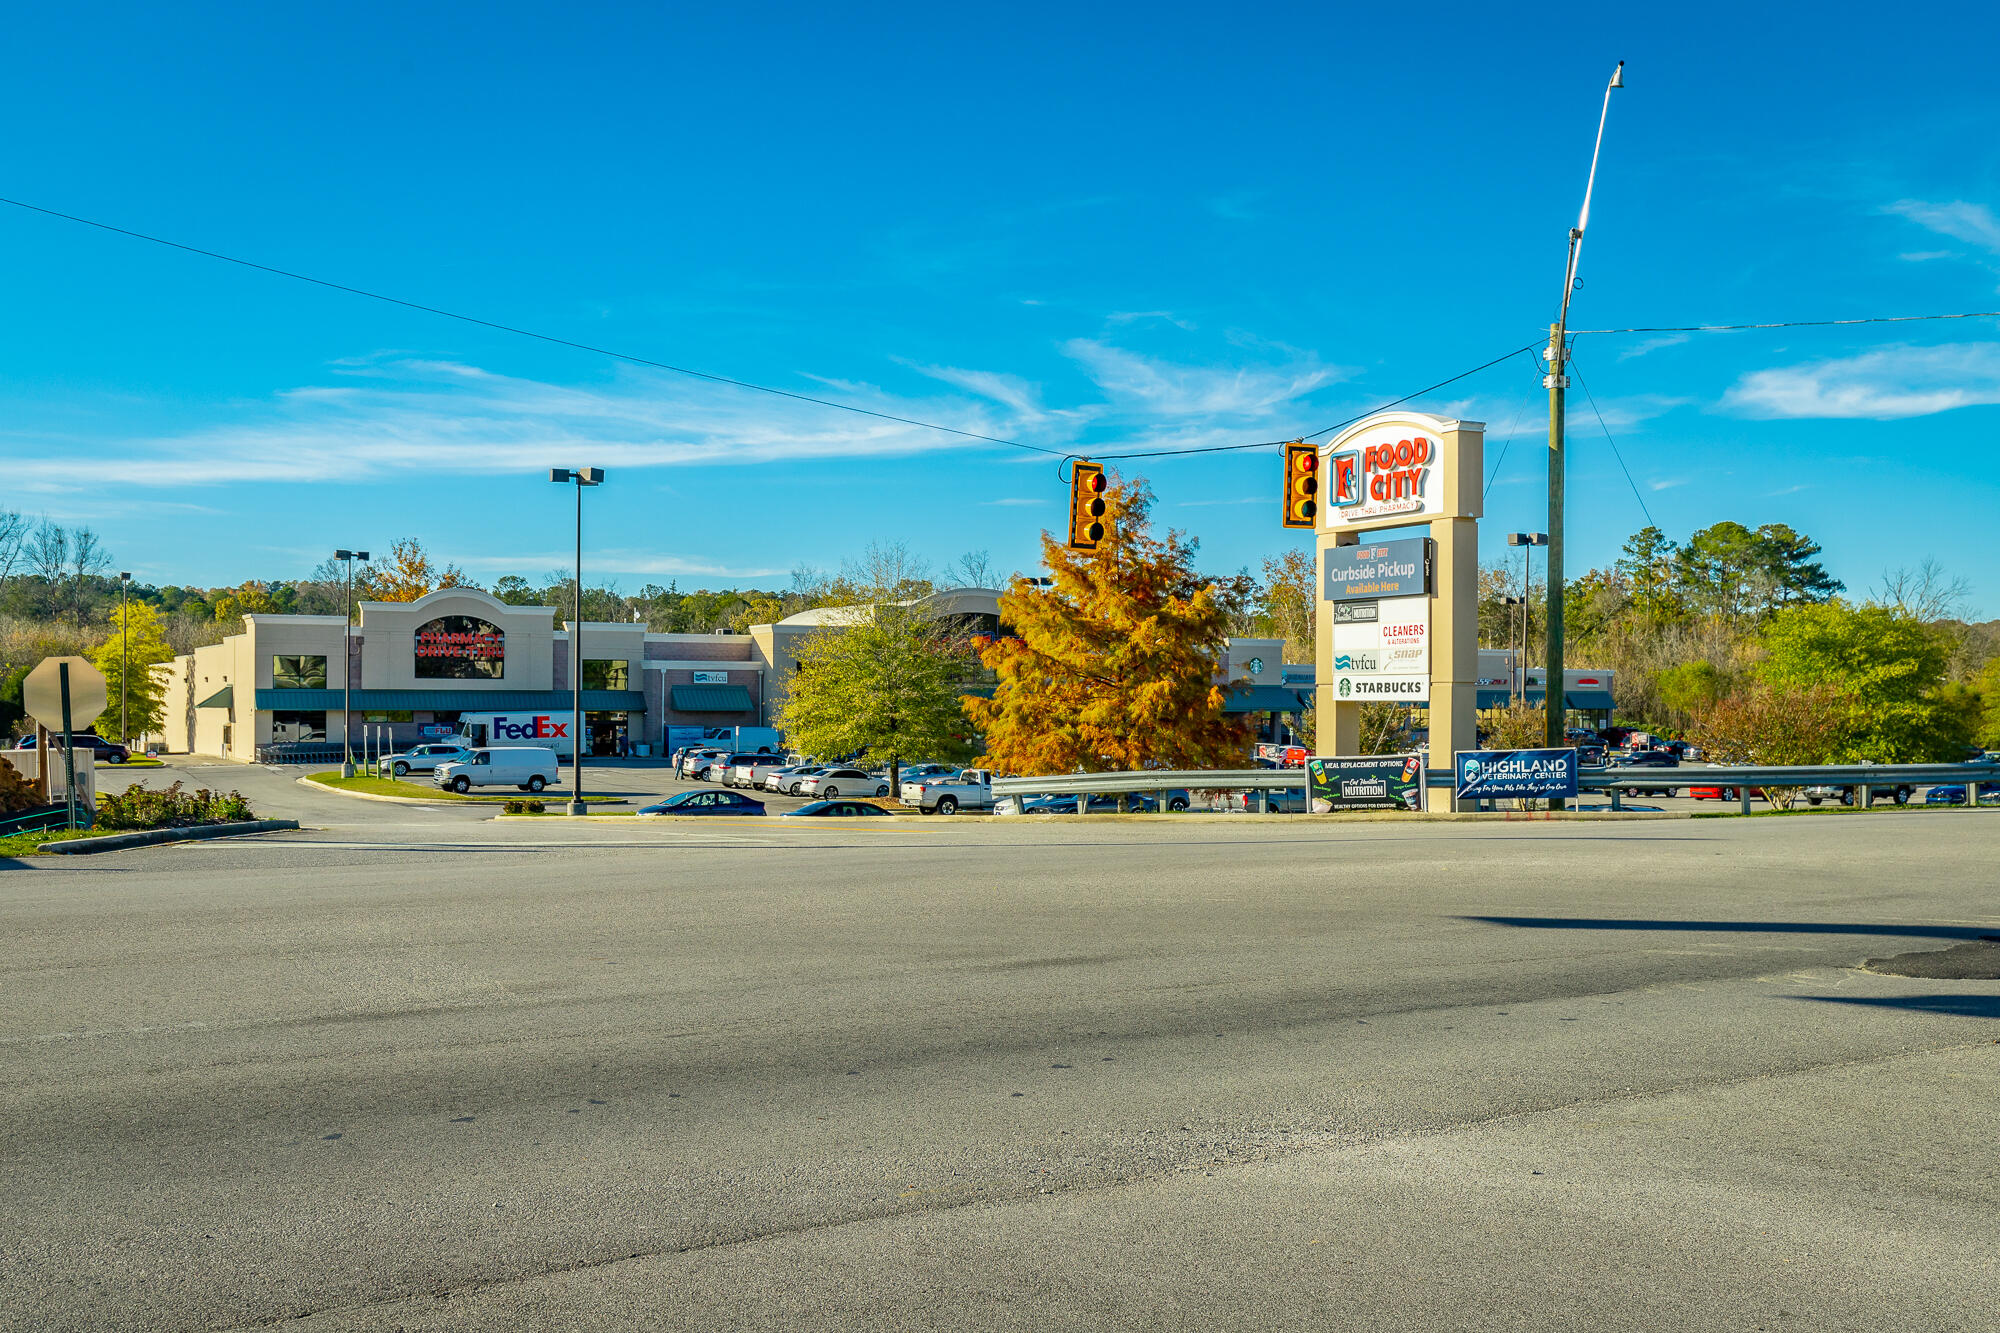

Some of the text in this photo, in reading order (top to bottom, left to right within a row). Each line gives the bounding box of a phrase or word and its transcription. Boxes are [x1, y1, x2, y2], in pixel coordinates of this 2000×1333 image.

[1365, 437, 1429, 473] FOOD
[1370, 468, 1423, 501] CITY
[1361, 506, 1377, 515] THRU
[1379, 501, 1414, 513] PHARMACY
[1331, 564, 1375, 582] Curbside
[1377, 561, 1416, 578] Pickup
[1345, 581, 1399, 595] Available Here
[1383, 624, 1425, 637] CLEANERS
[420, 632, 502, 644] PHARMACY
[1391, 637, 1420, 645] ALTERATIONS
[1351, 653, 1377, 670] tvfcu
[706, 673, 727, 683] tvfcu
[1355, 682, 1421, 694] STARBUCKS
[435, 727, 452, 735] FLU
[493, 716, 569, 740] FedEx
[1340, 761, 1378, 769] REPLACEMENT
[1379, 760, 1404, 768] OPTIONS
[1481, 759, 1568, 773] HIGHLAND
[1482, 771, 1567, 780] VETERINARY CENTER
[1344, 785, 1384, 796] NUTRITION
